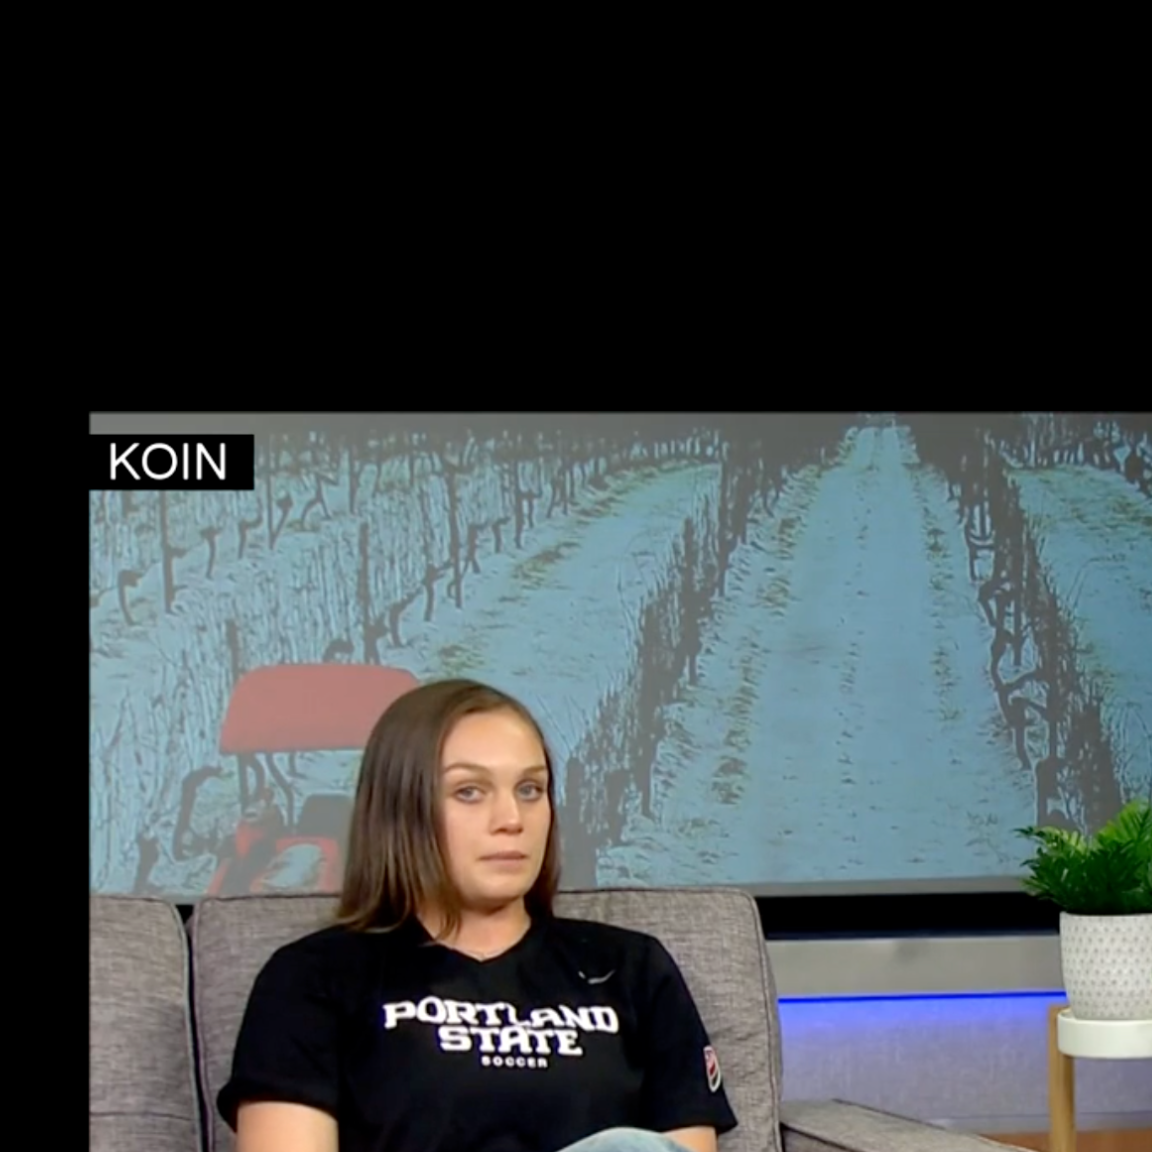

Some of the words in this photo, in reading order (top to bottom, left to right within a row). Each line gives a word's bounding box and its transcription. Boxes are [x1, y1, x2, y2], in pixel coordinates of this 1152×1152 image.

[383, 996, 619, 1032] PORTLAND
[438, 1025, 583, 1056] STATE
[481, 1055, 549, 1068] SOCCER
